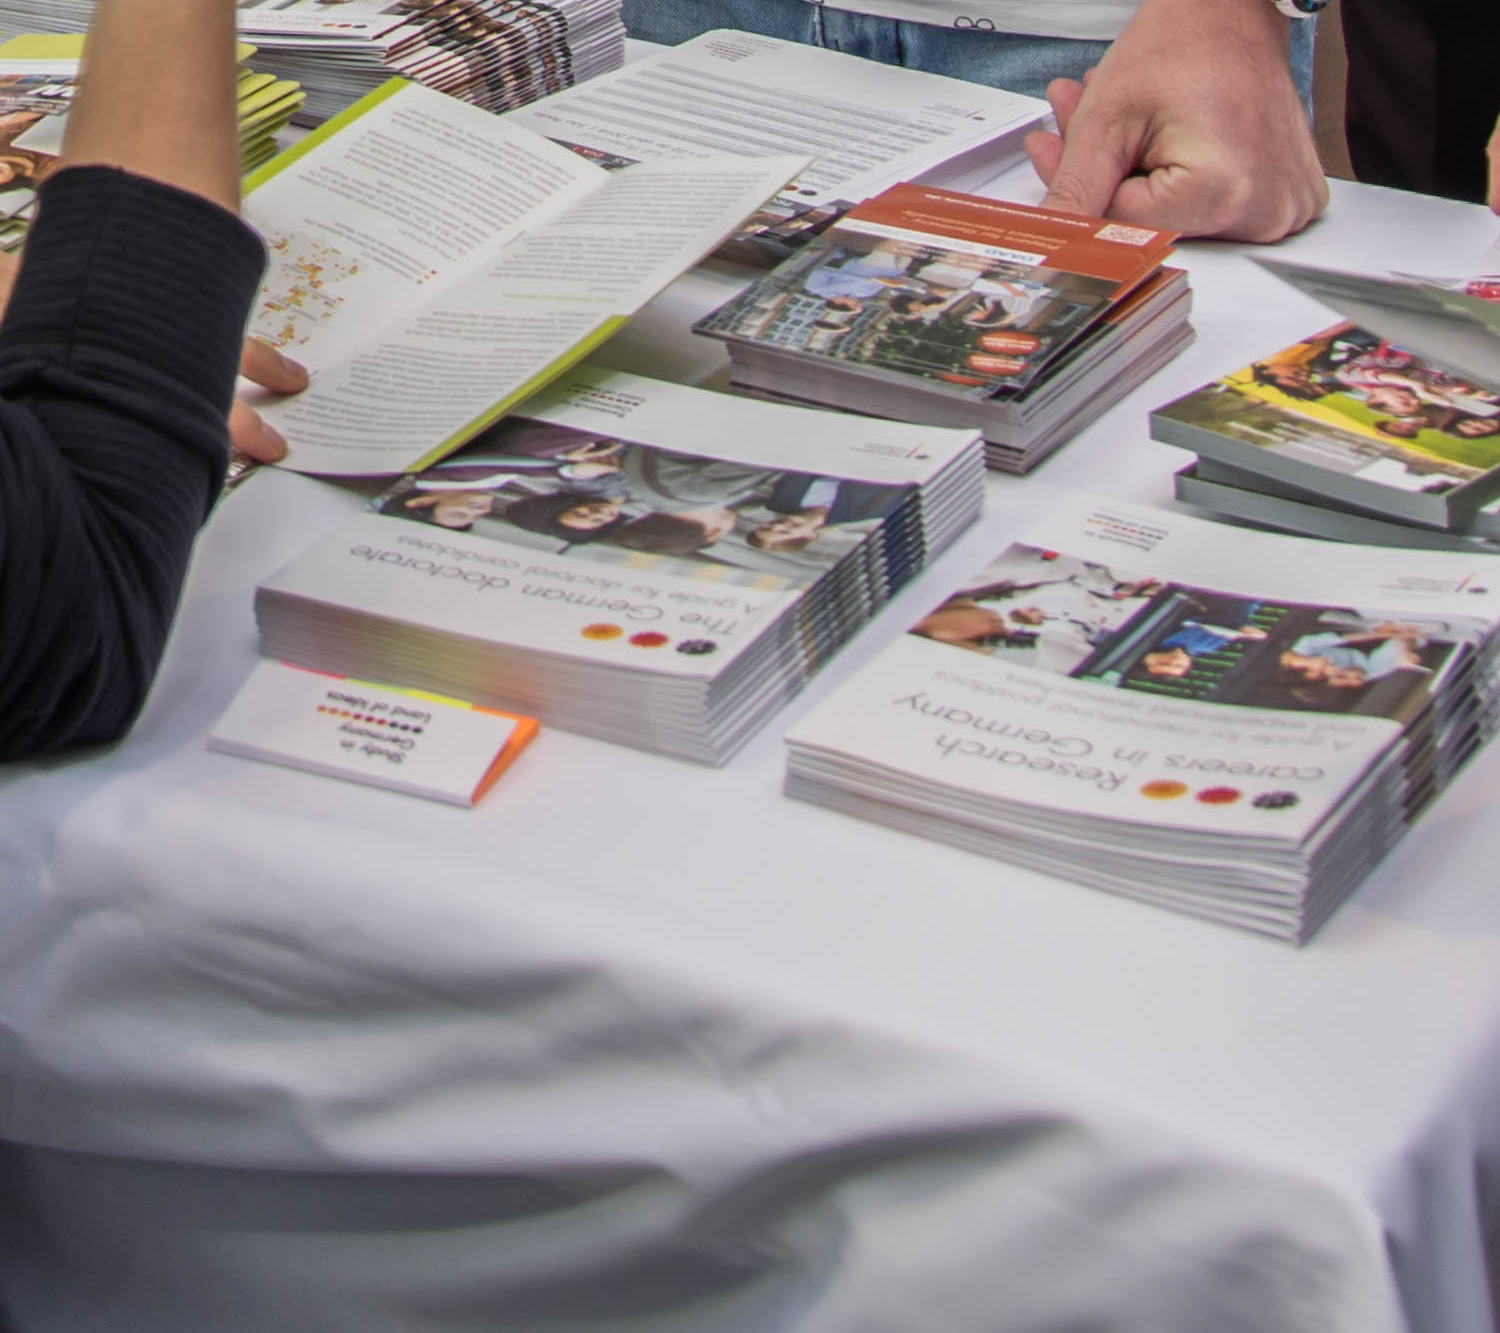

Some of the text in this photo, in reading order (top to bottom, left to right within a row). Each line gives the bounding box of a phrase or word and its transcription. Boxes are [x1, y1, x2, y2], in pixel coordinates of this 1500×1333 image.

[347, 544, 739, 636] The German doctorate
[890, 691, 1327, 783] careers in Germany
[934, 733, 1129, 793] Research
